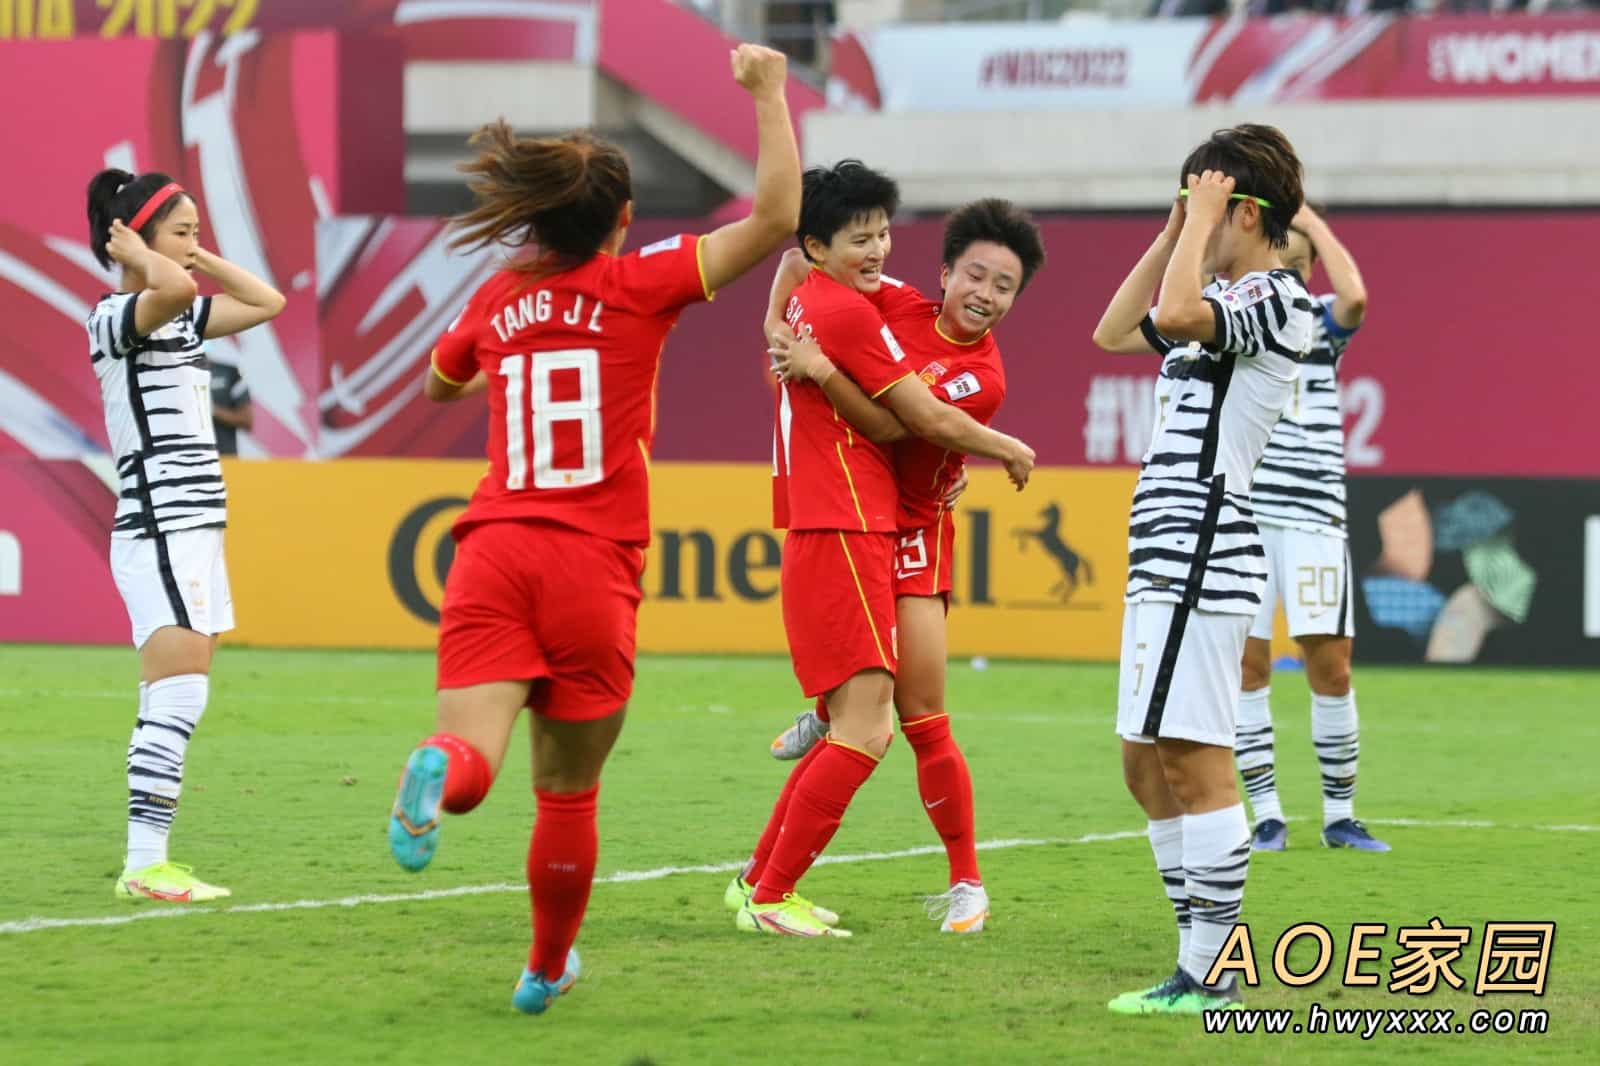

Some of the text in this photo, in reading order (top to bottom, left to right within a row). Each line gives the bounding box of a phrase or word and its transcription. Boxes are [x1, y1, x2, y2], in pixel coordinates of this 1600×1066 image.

[490, 290, 604, 343] TANG J L
[499, 348, 604, 490] 18
[1297, 566, 1338, 606] 20
